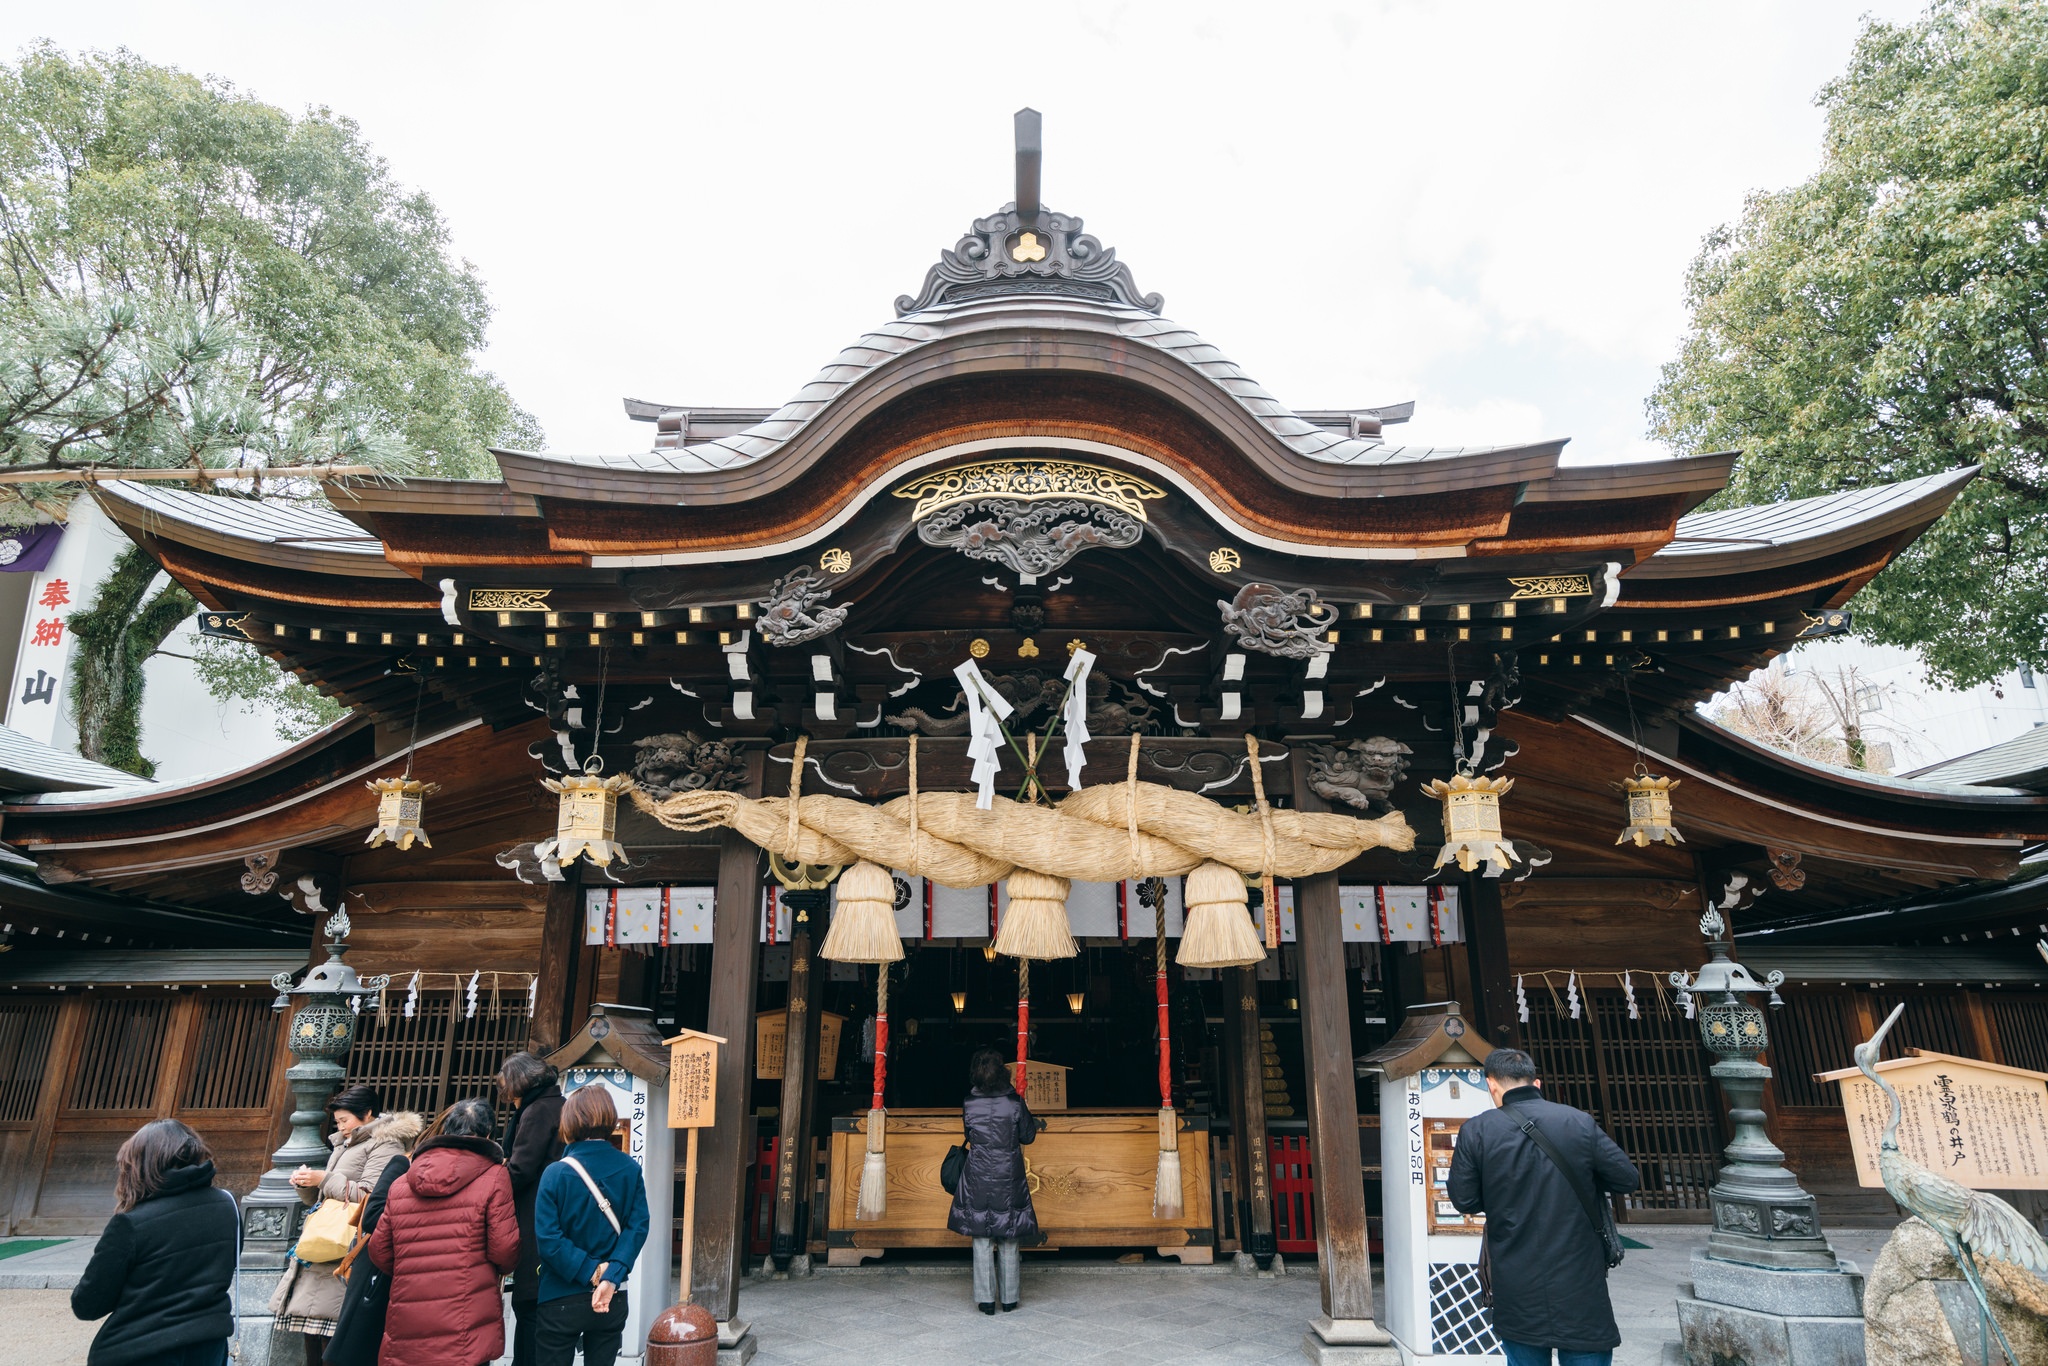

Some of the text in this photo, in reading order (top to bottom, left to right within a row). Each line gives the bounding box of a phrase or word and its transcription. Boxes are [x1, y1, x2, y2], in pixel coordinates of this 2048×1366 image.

[21, 579, 70, 705] 奉納 山
[1408, 1092, 1424, 1186] おみくじ50円
[1933, 1074, 1966, 1167] 霊泉鶴の井戸
